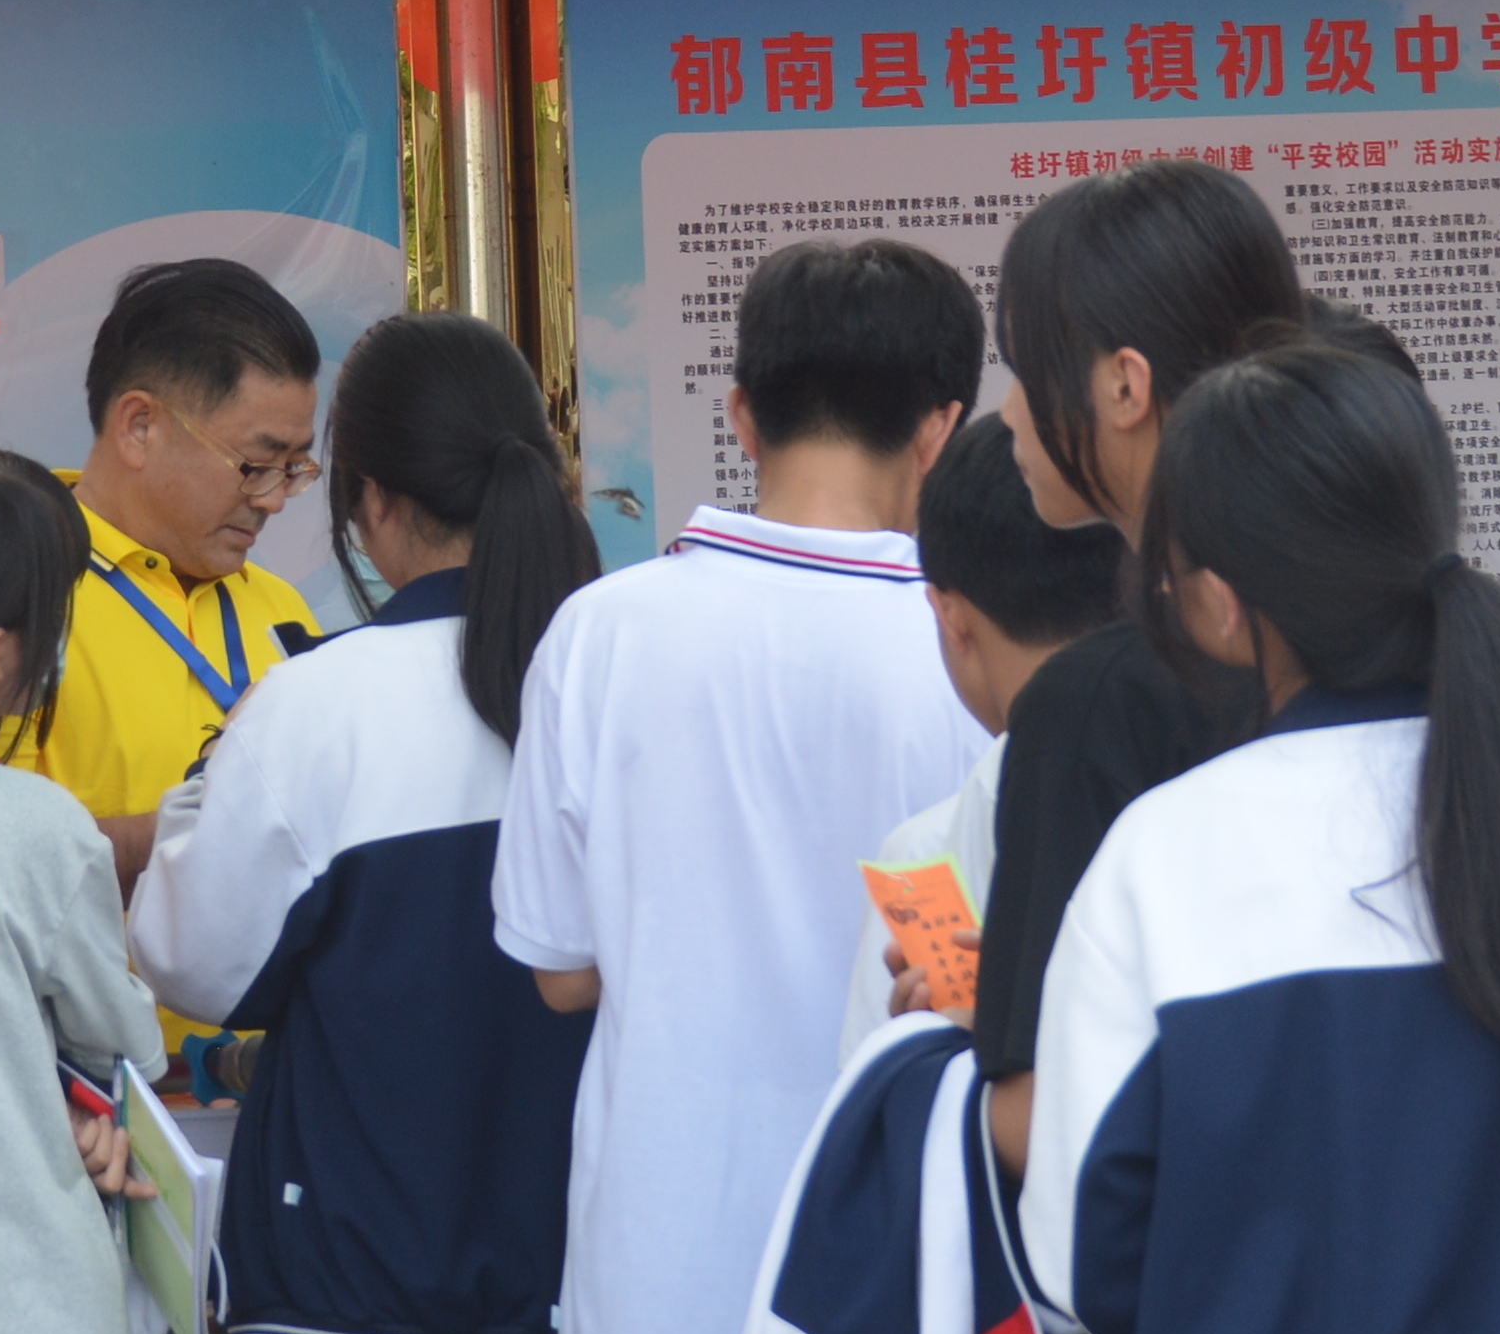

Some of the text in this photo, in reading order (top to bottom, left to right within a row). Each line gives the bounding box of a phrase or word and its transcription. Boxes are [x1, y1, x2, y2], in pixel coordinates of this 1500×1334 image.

[707, 274, 751, 288] 坚持以
[715, 468, 757, 482] 领导小
